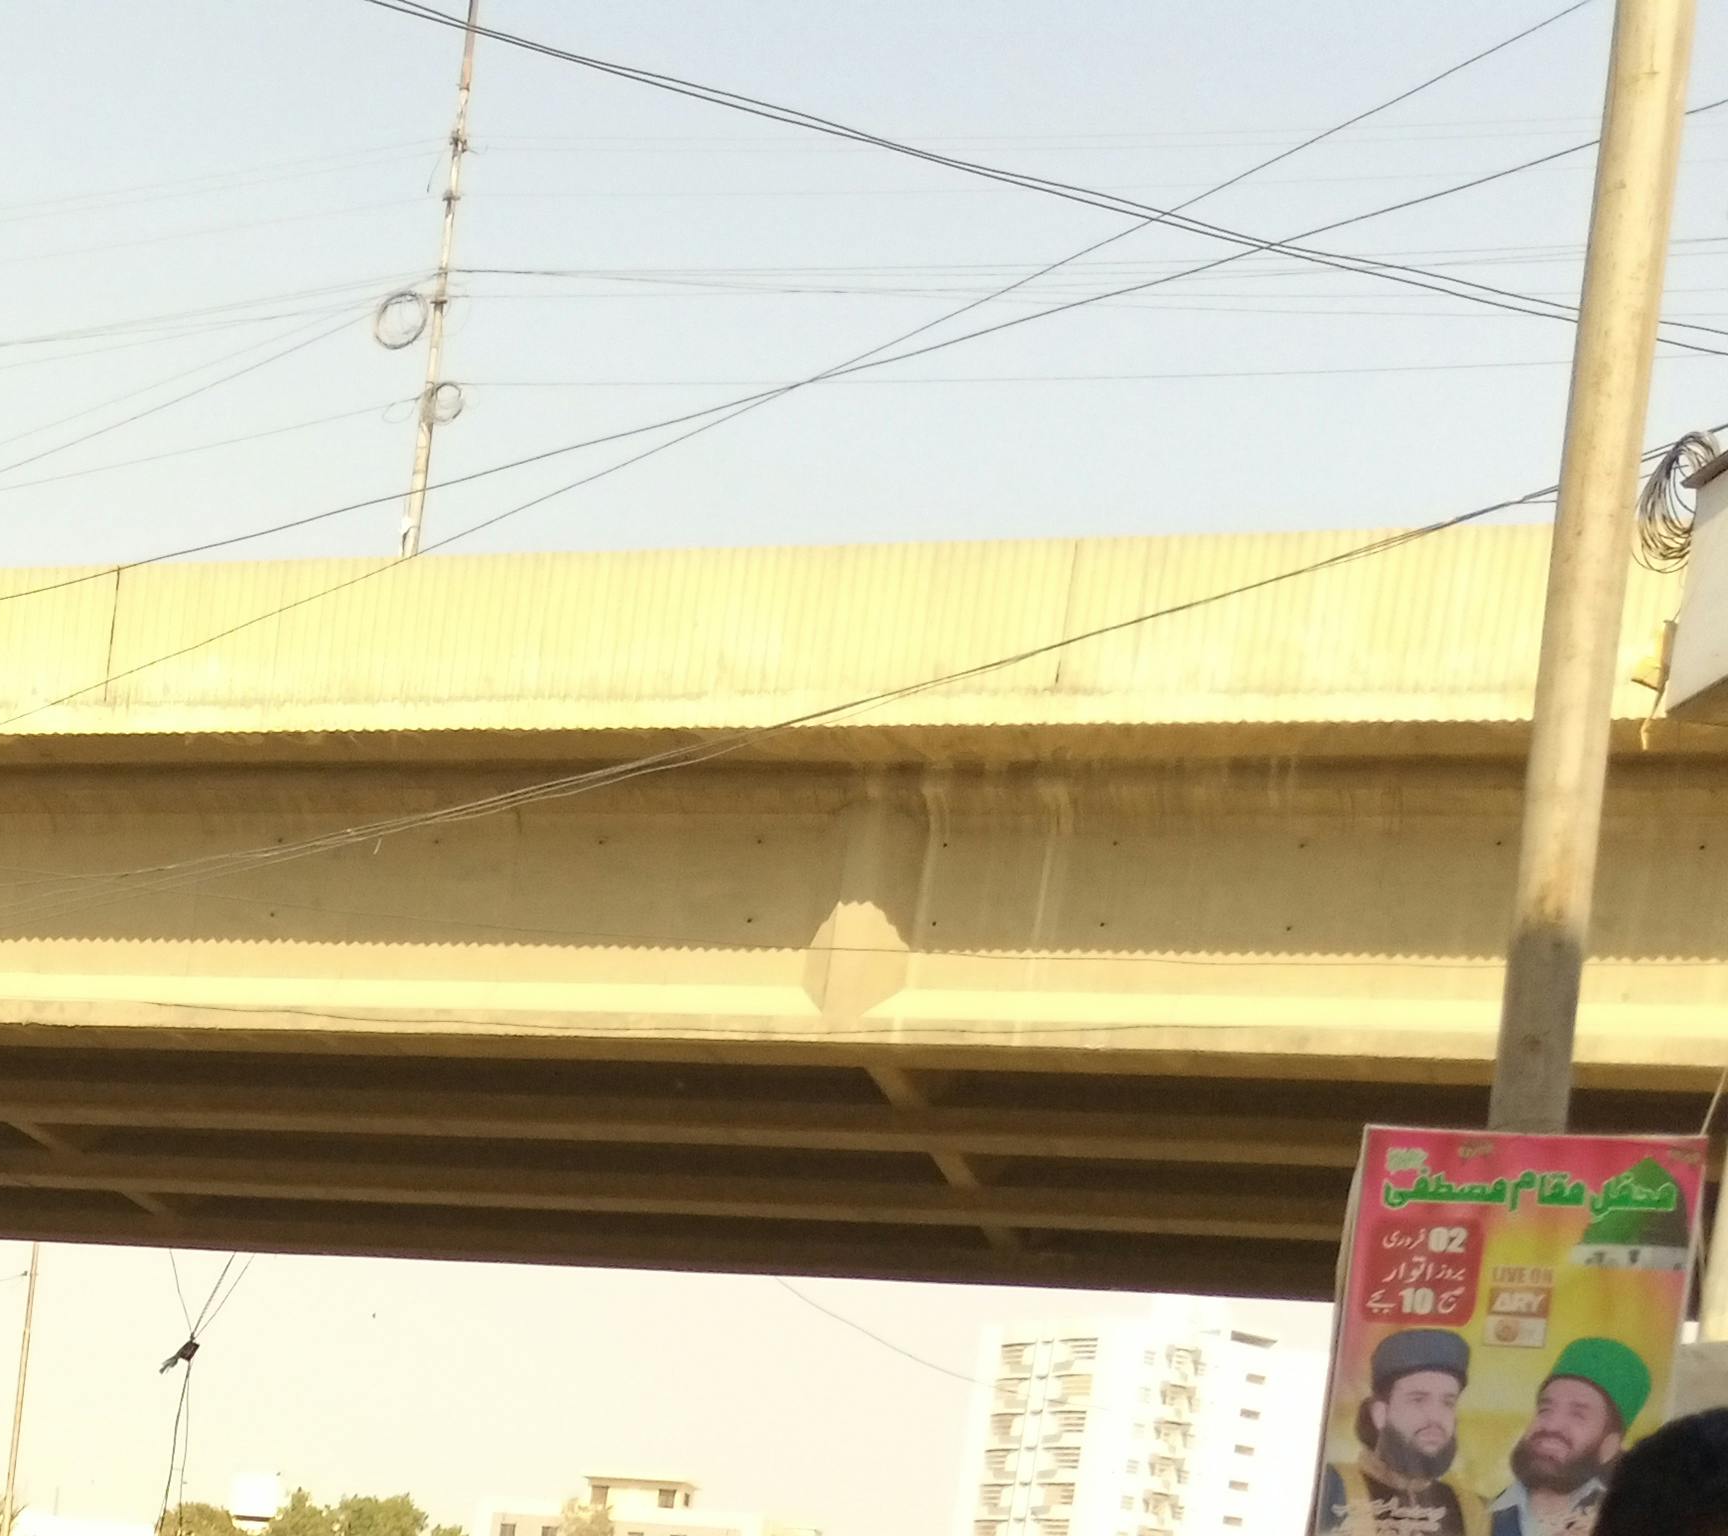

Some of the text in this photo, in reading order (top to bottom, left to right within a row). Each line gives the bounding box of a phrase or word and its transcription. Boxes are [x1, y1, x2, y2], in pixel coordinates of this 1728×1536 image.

[1508, 1170, 1585, 1212] مقام
[1428, 1226, 1468, 1252] 02
[1382, 1256, 1433, 1282] اتوار
[1399, 1288, 1434, 1314] 10
